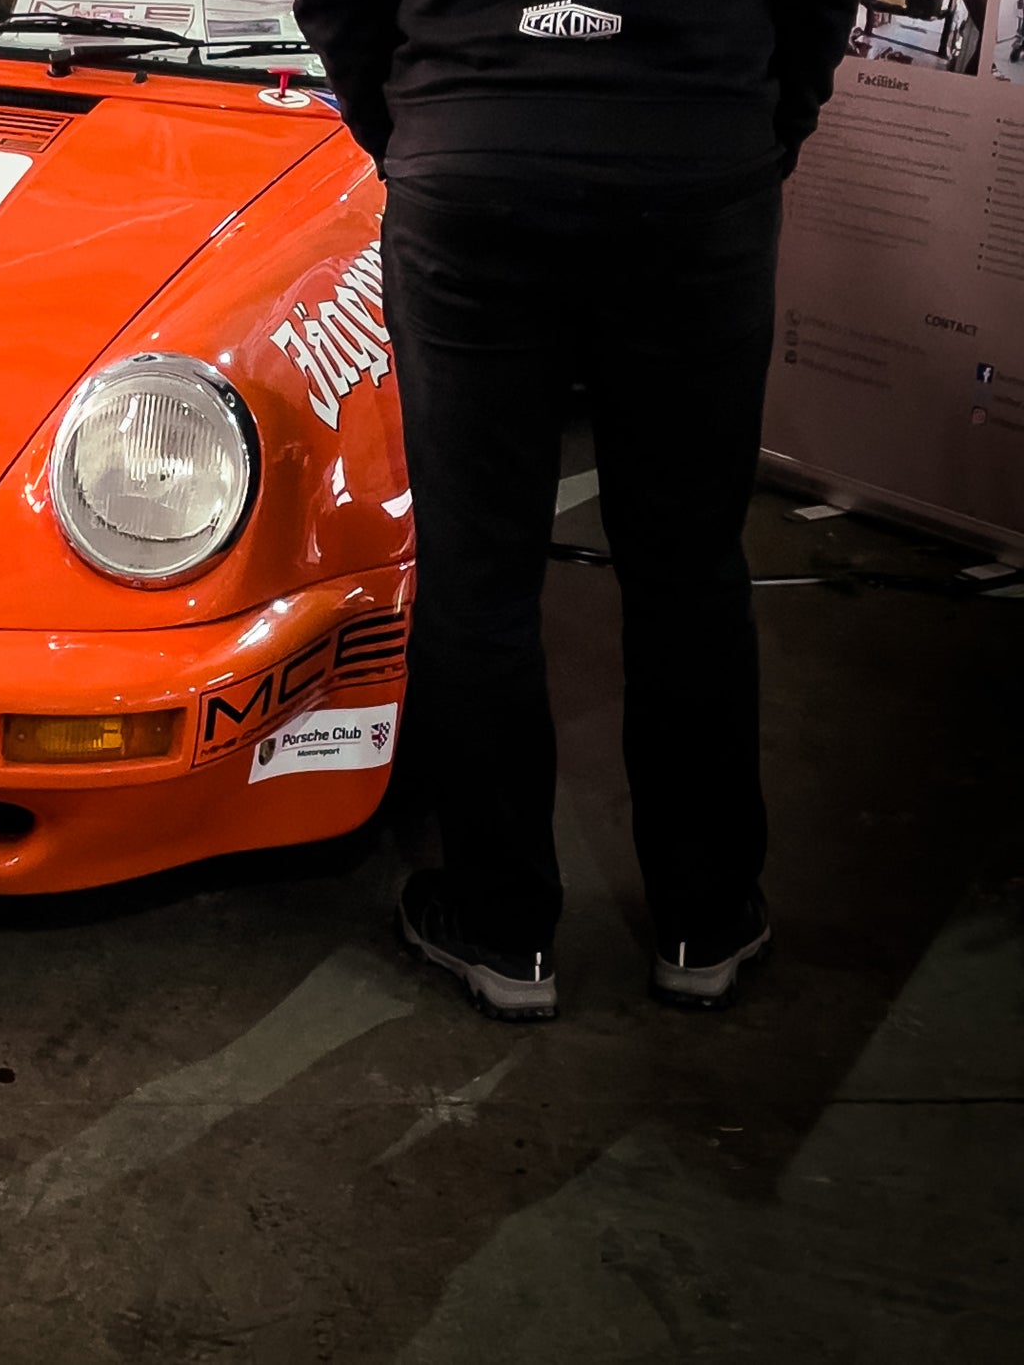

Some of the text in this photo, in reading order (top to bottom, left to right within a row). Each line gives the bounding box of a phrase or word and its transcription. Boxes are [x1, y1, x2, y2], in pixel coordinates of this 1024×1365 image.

[857, 72, 910, 92] Facilities
[924, 313, 980, 336] CONTACT
[204, 612, 405, 742] MCE
[281, 726, 362, 747] Porsche Club
